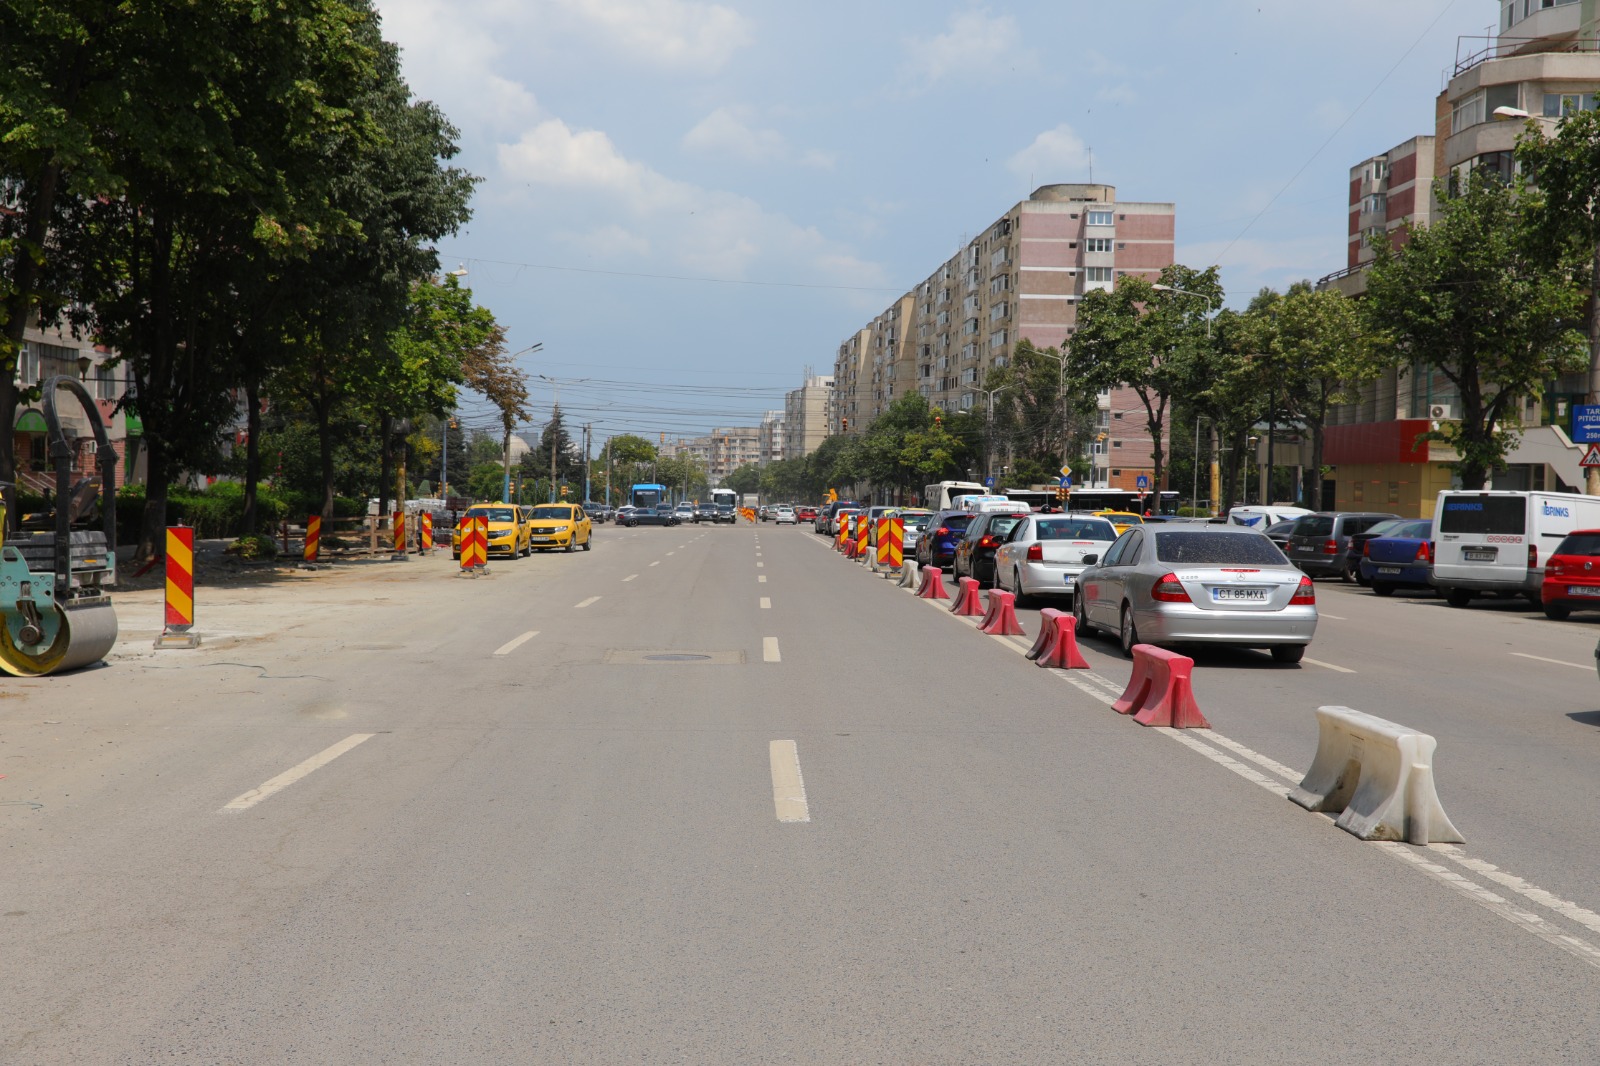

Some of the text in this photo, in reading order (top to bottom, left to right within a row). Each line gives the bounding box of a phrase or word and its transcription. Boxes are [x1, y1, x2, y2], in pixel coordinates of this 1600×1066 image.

[1545, 506, 1569, 517] BRINKS
[1220, 590, 1265, 599] CT 85 MXA
